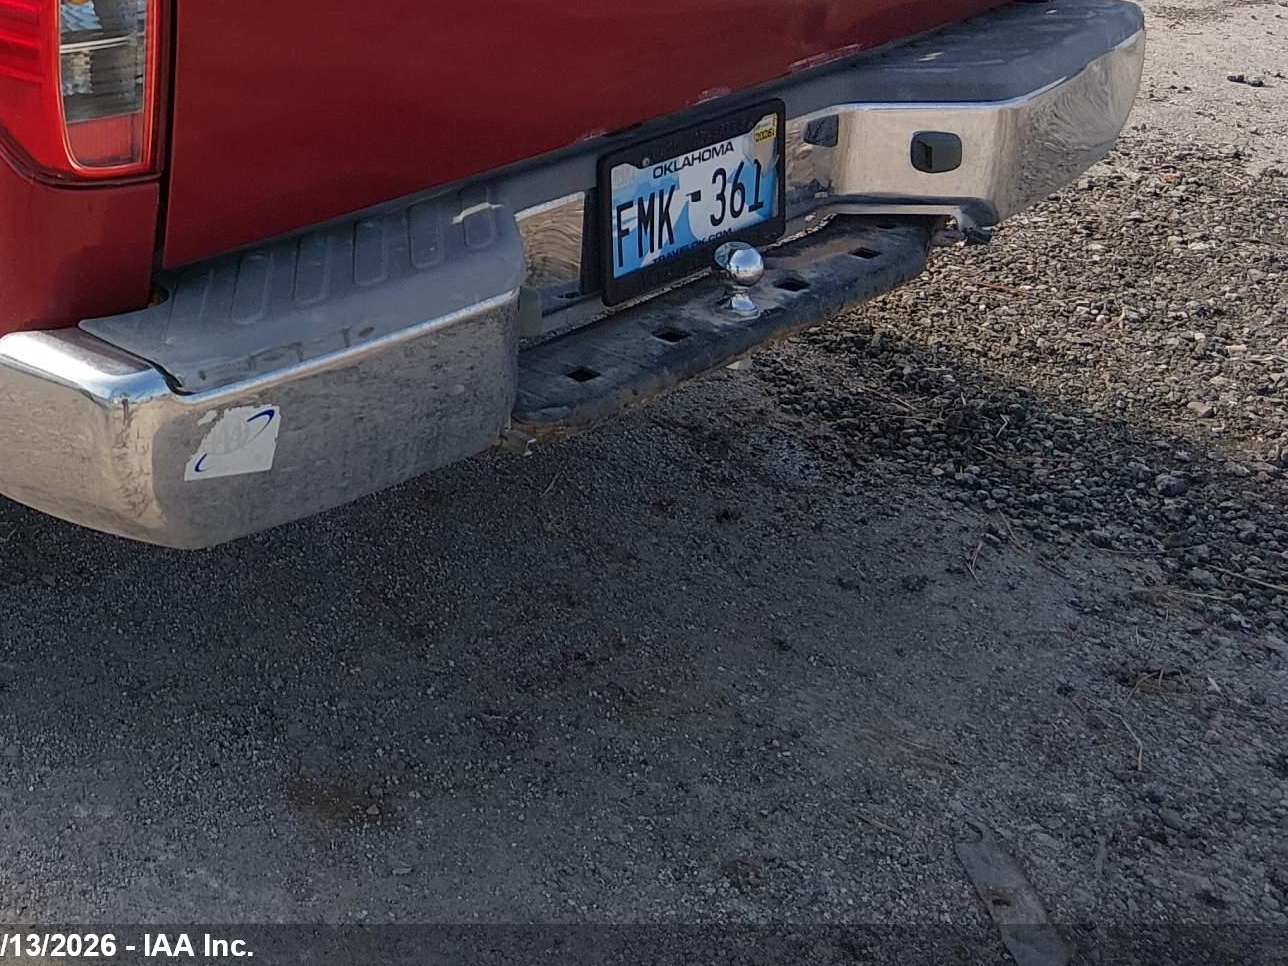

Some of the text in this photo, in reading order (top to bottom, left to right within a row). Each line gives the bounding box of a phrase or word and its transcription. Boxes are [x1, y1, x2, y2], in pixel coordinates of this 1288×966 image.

[653, 141, 734, 179] OKLAHOMA
[616, 159, 764, 267] FMK 361
